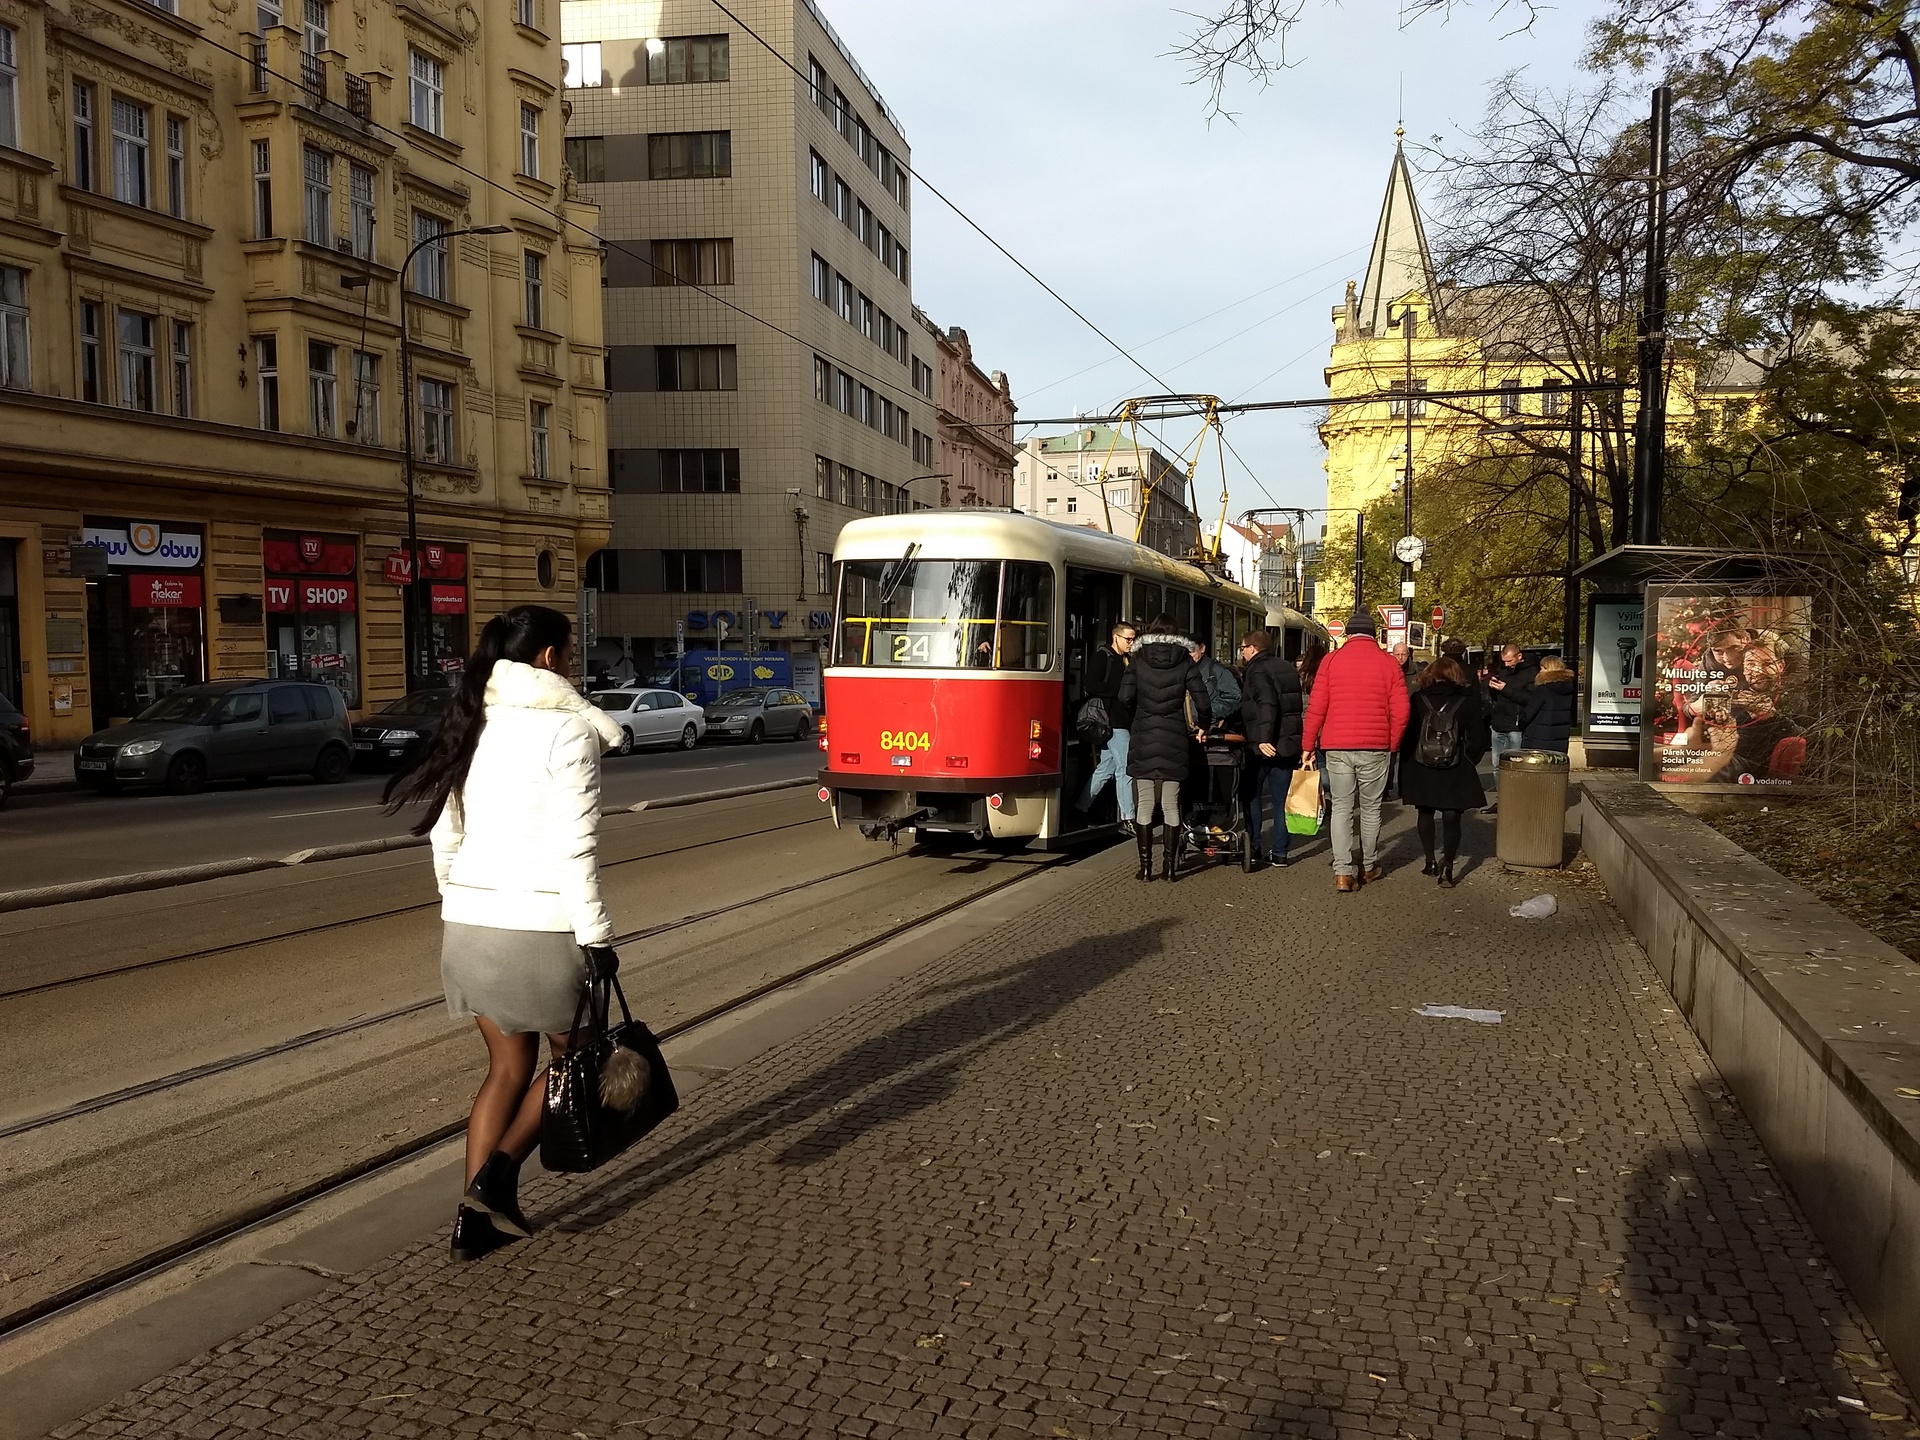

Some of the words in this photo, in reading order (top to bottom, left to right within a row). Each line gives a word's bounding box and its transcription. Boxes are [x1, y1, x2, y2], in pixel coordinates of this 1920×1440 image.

[305, 542, 318, 552] TV
[430, 550, 441, 559] TV
[388, 556, 412, 575] TV
[151, 588, 183, 599] rieker
[268, 587, 290, 604] TV
[306, 587, 348, 604] SHOP
[687, 610, 788, 630] SOY
[893, 635, 930, 662] 24
[1665, 668, 1708, 681] Milujte
[1709, 670, 1725, 679] se
[1664, 684, 1673, 692] a
[1675, 682, 1713, 694] spojte
[1715, 684, 1729, 692] se
[879, 730, 931, 752] 8404
[1662, 756, 1685, 764] Social
[1755, 777, 1793, 786] vodafone
